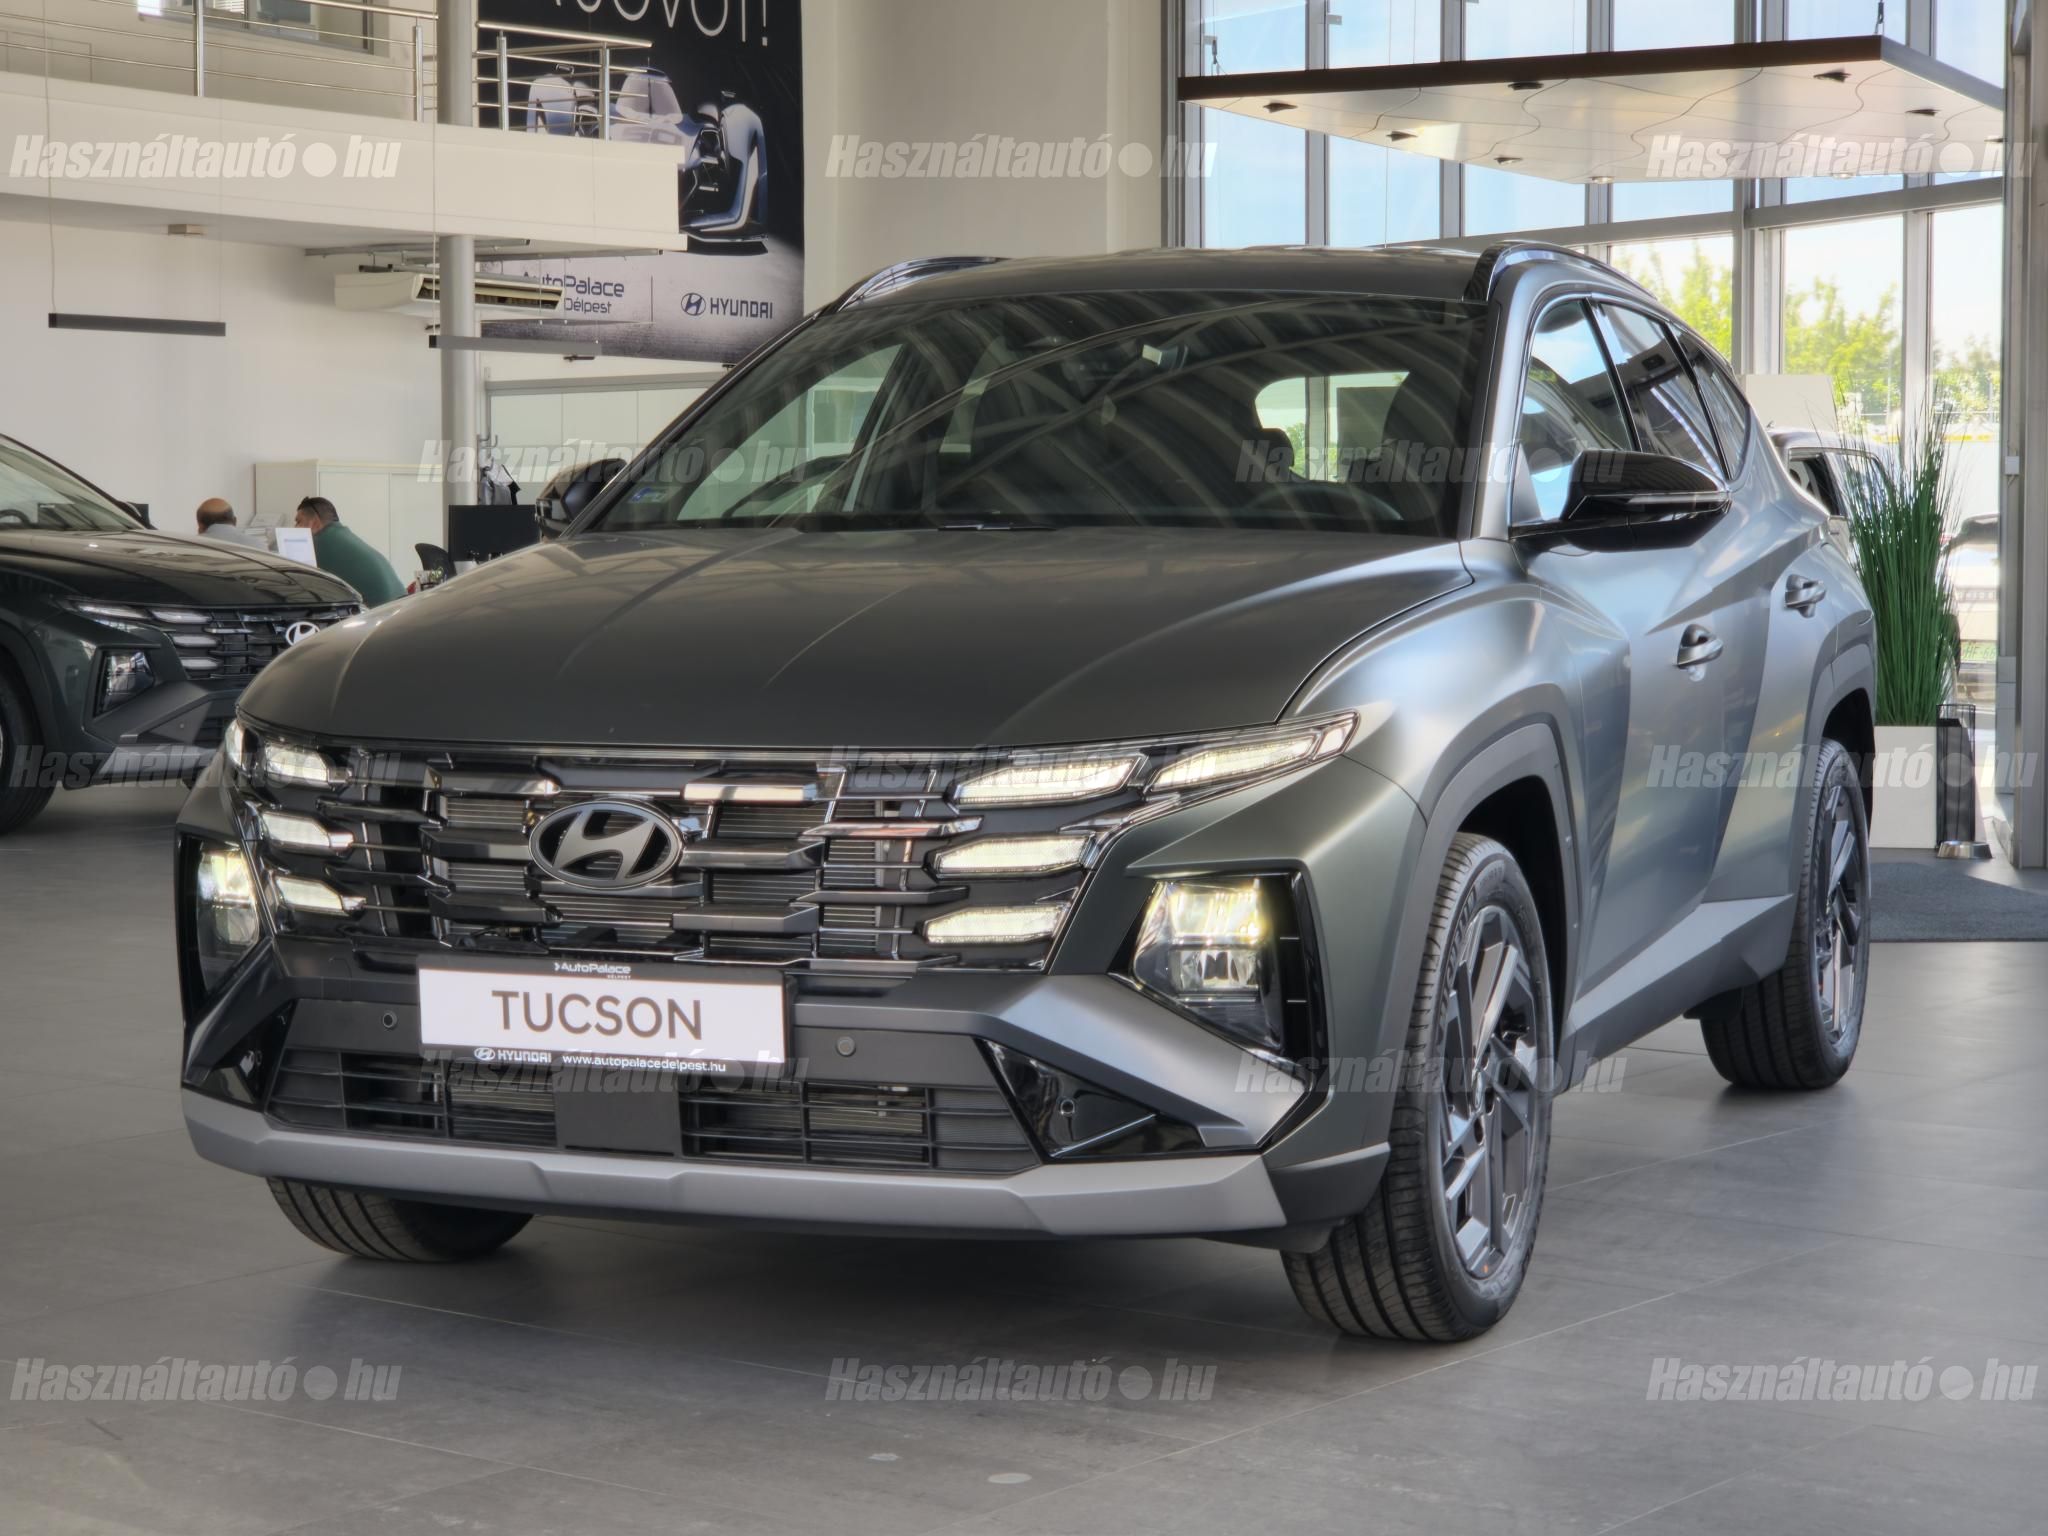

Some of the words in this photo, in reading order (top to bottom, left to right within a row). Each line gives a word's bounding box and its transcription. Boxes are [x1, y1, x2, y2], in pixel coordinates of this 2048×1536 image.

[563, 297, 612, 314] Délpest
[710, 297, 773, 319] HYUNDAI
[561, 961, 632, 975] AutoPalace
[491, 989, 703, 1041] TUCSON
[497, 1049, 552, 1064] HYUNDAI
[562, 1053, 727, 1073] www.autopalacedelpest.hu
